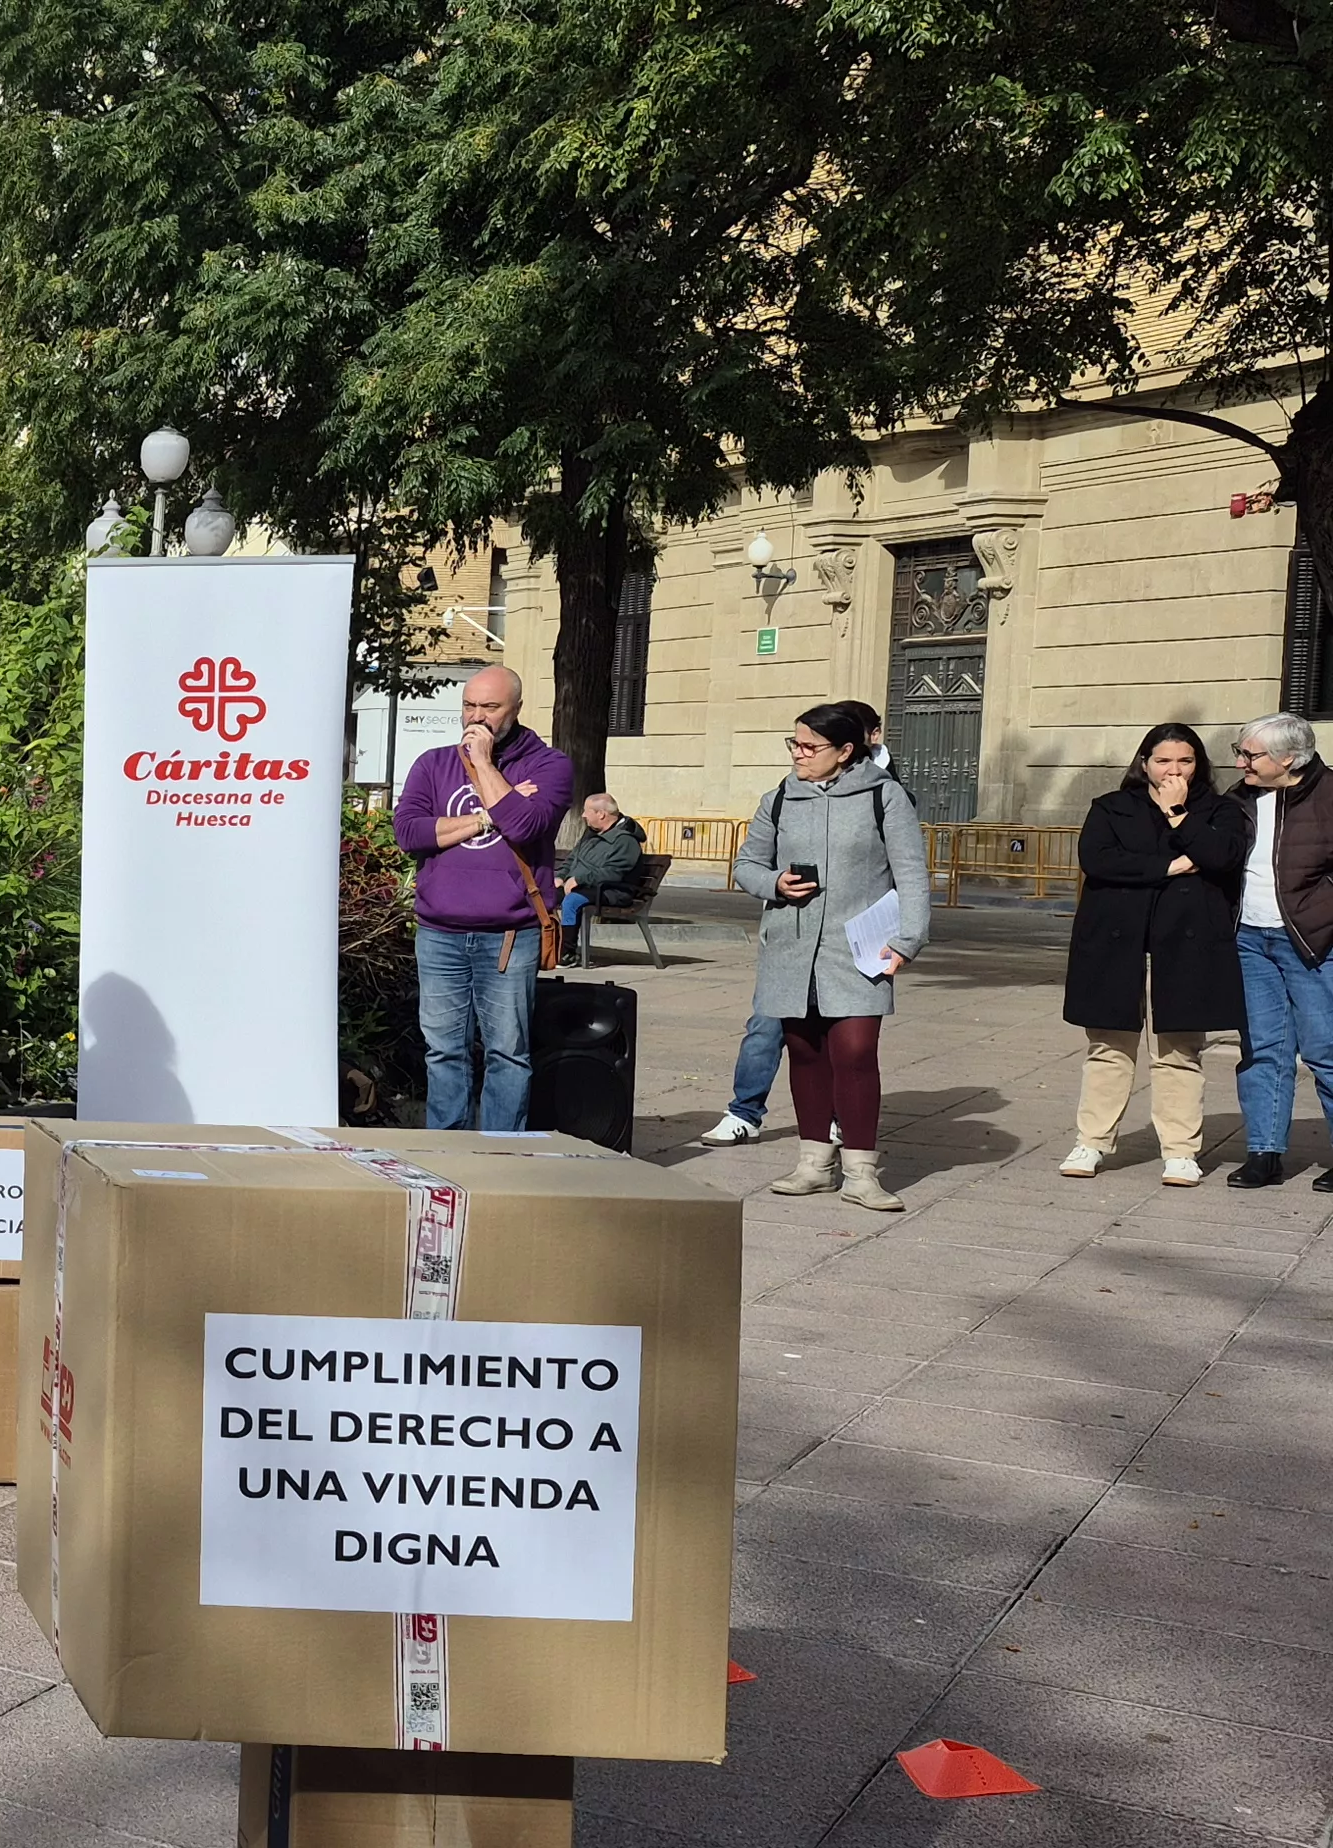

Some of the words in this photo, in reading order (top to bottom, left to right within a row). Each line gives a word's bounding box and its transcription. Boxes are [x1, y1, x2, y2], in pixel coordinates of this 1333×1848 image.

[123, 749, 310, 781] Cáritas
[146, 789, 253, 805] Diocesana
[259, 789, 285, 805] de
[176, 811, 252, 826] Huesca
[224, 1346, 620, 1392] CUMPLIMIENTO
[220, 1406, 314, 1442] DEL
[329, 1409, 574, 1452] DERECHO
[588, 1421, 623, 1453] A
[238, 1466, 348, 1502] UNA
[361, 1471, 601, 1511] VIVIENDA
[334, 1529, 501, 1568] DIGNA
